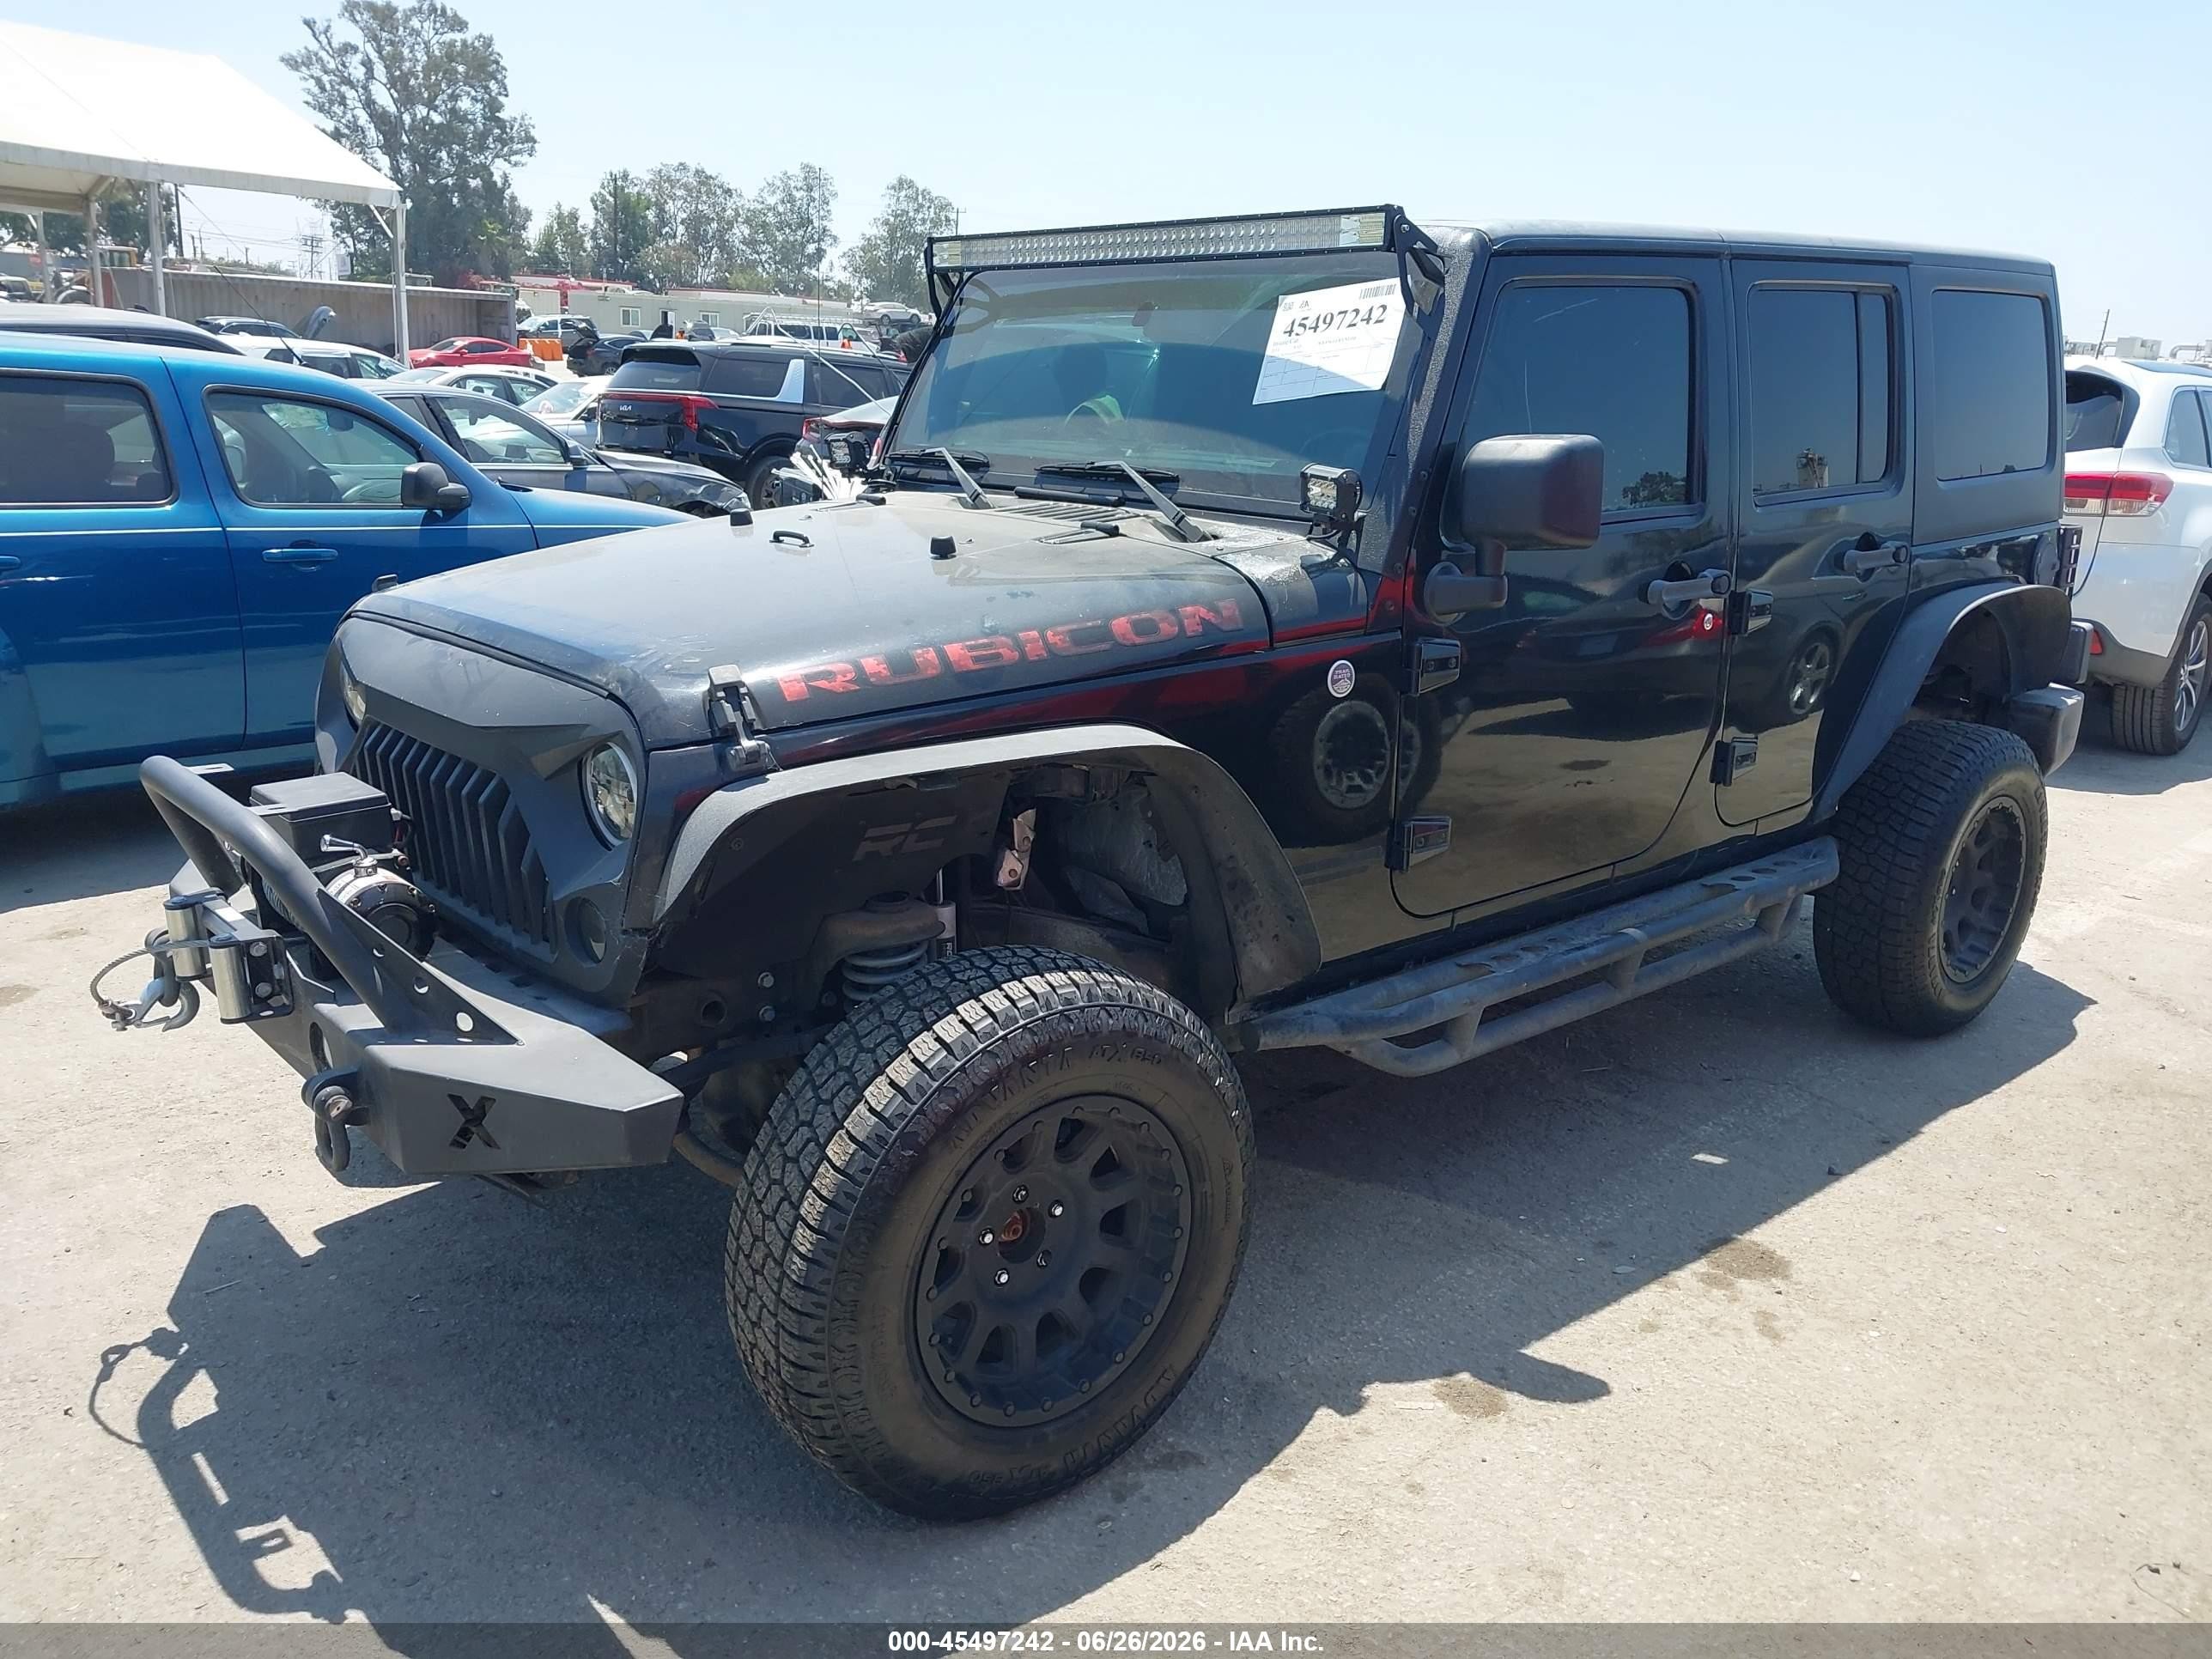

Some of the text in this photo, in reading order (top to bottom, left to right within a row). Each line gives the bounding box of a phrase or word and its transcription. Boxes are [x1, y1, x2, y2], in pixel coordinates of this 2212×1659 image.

[1283, 304, 1388, 337] 45497242
[778, 599, 1244, 702] RUBICON
[852, 815, 958, 863] RC
